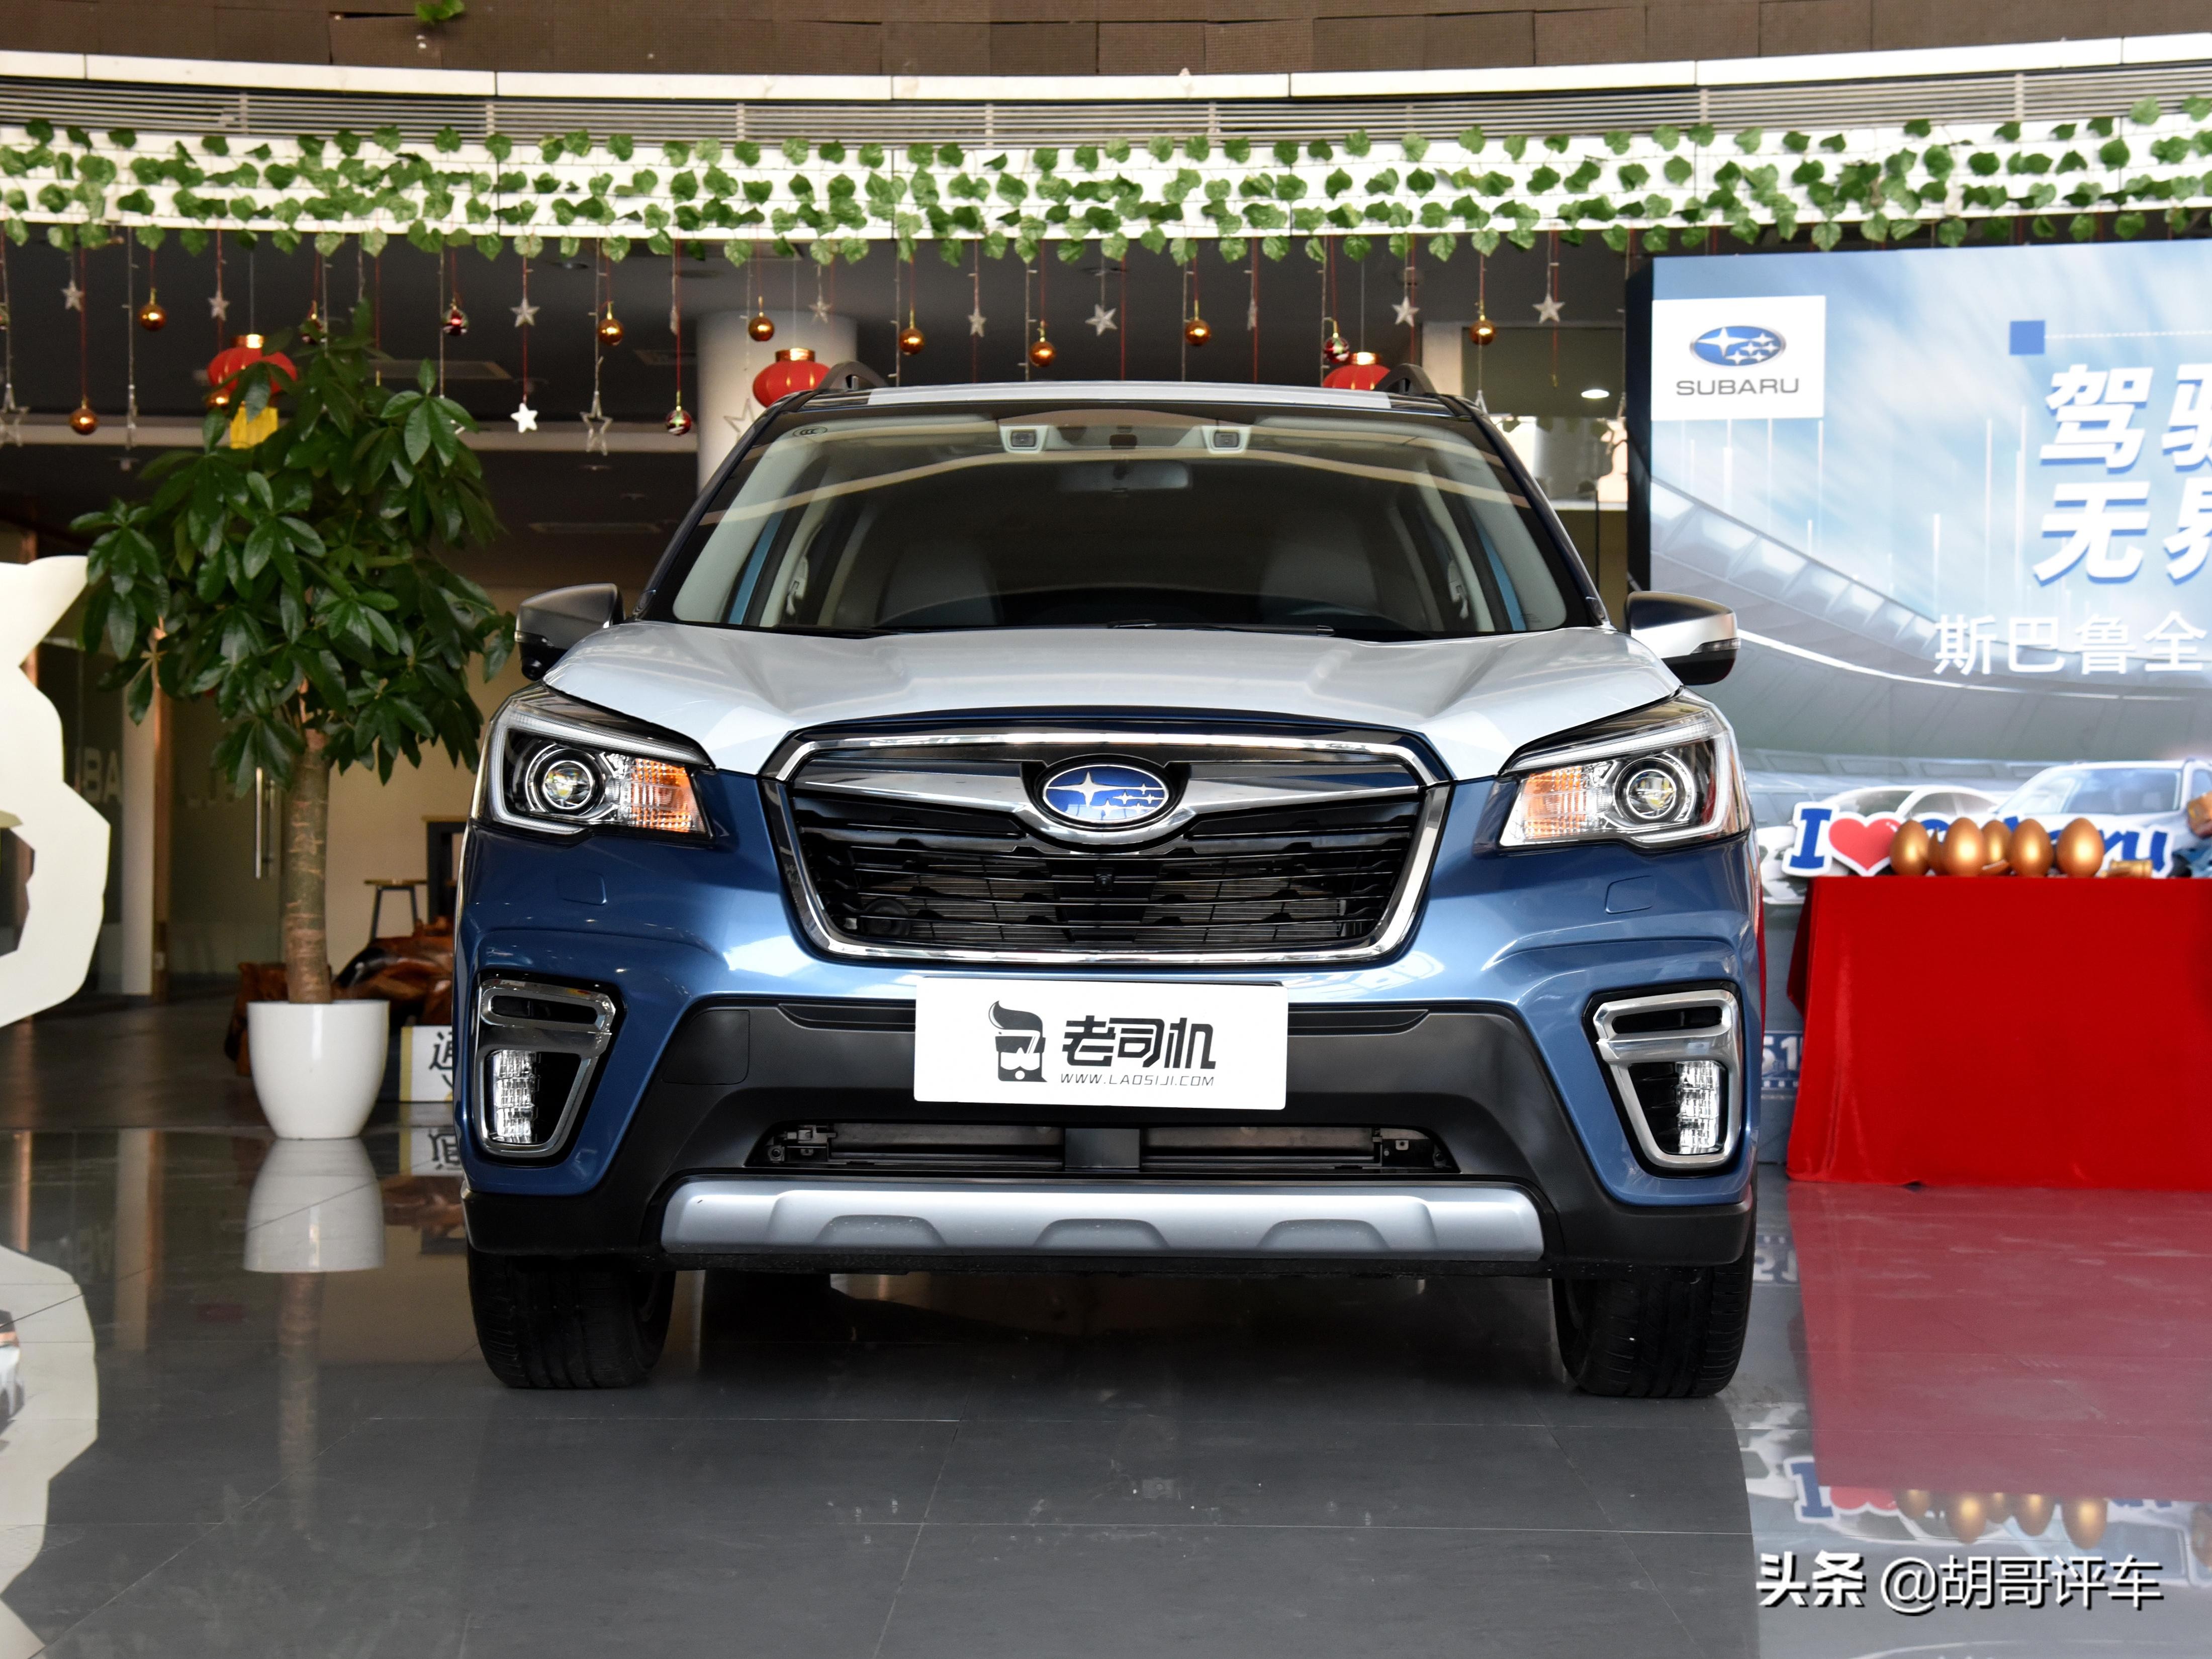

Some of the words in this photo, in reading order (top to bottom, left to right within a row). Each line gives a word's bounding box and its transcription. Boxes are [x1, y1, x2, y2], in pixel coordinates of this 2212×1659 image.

[1676, 378, 1799, 396] SUBARU
[1934, 610, 2207, 676] 斯巴鲁全
[1062, 1015, 1216, 1069] 老司机
[1061, 1073, 1215, 1086] WWW.LAOSIJI.COM
